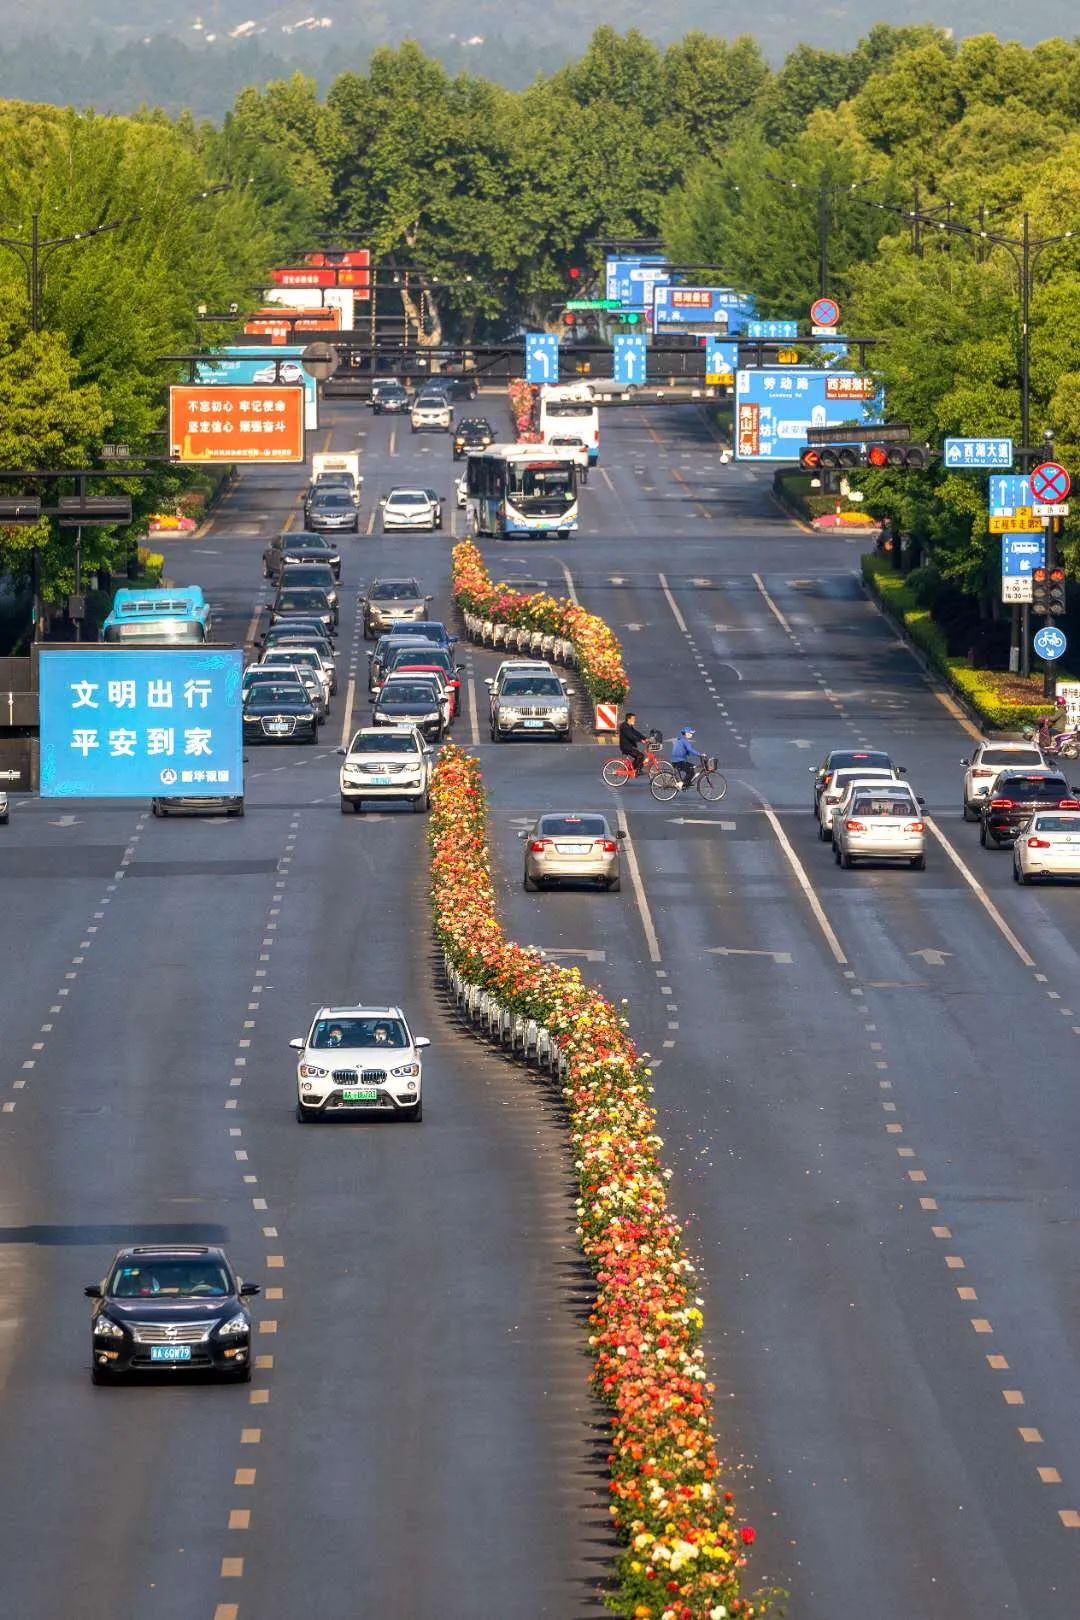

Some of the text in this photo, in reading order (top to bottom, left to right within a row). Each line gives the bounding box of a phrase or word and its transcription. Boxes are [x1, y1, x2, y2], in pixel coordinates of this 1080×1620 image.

[763, 377, 809, 390] 劳动路
[187, 400, 286, 413] 不忘初心 牢记使命
[187, 420, 234, 433] 坚定信心
[740, 406, 752, 455] 吴山广场
[963, 443, 1009, 457] 西湖大道
[1020, 508, 1027, 516] 2
[70, 679, 213, 709] 文明出行
[70, 727, 213, 757] 平安到家
